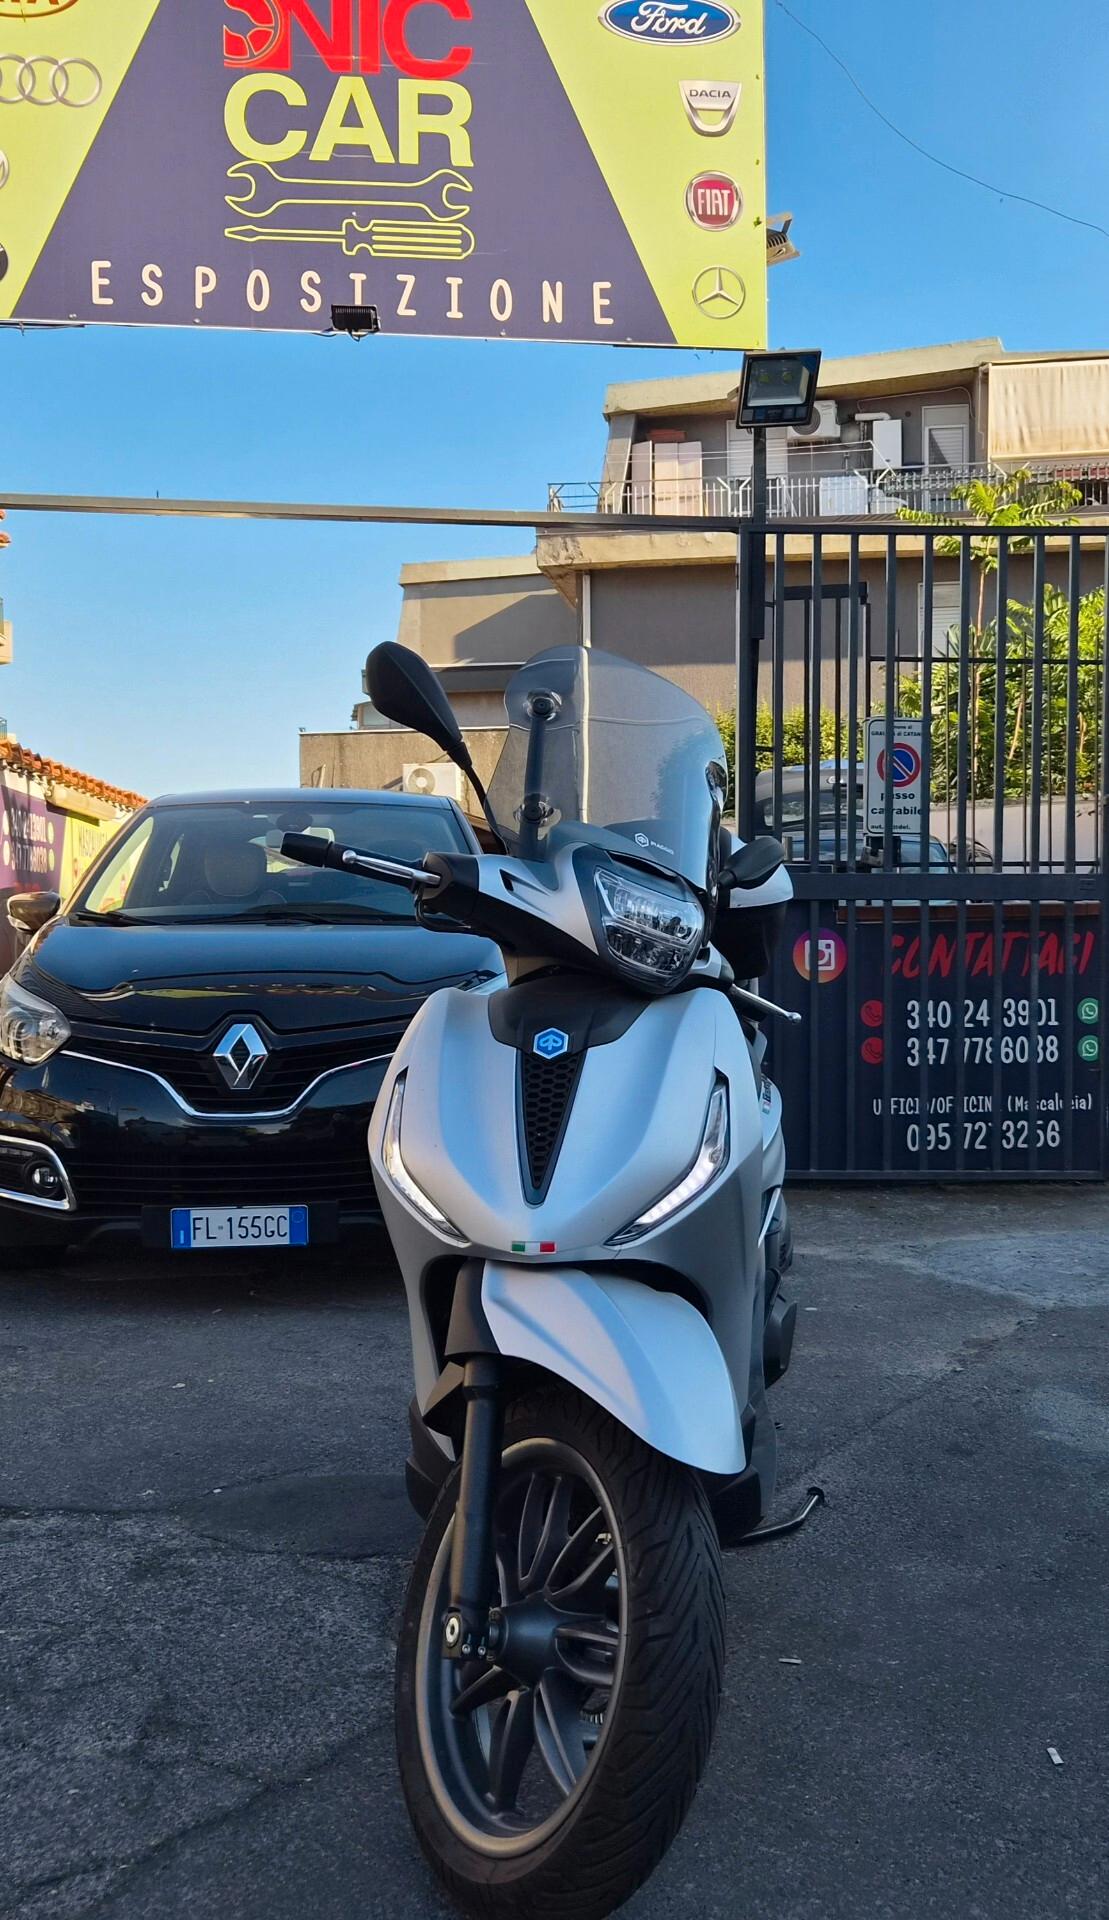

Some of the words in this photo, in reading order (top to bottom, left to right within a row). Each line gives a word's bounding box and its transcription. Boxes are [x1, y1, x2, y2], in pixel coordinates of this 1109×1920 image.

[630, 1, 708, 35] Ford
[689, 89, 731, 98] DACIA
[223, 73, 474, 167] CAR
[697, 188, 731, 216] FIAT
[91, 260, 614, 325] ESPOSIZIONE
[226, 1215, 288, 1240] 155GC
